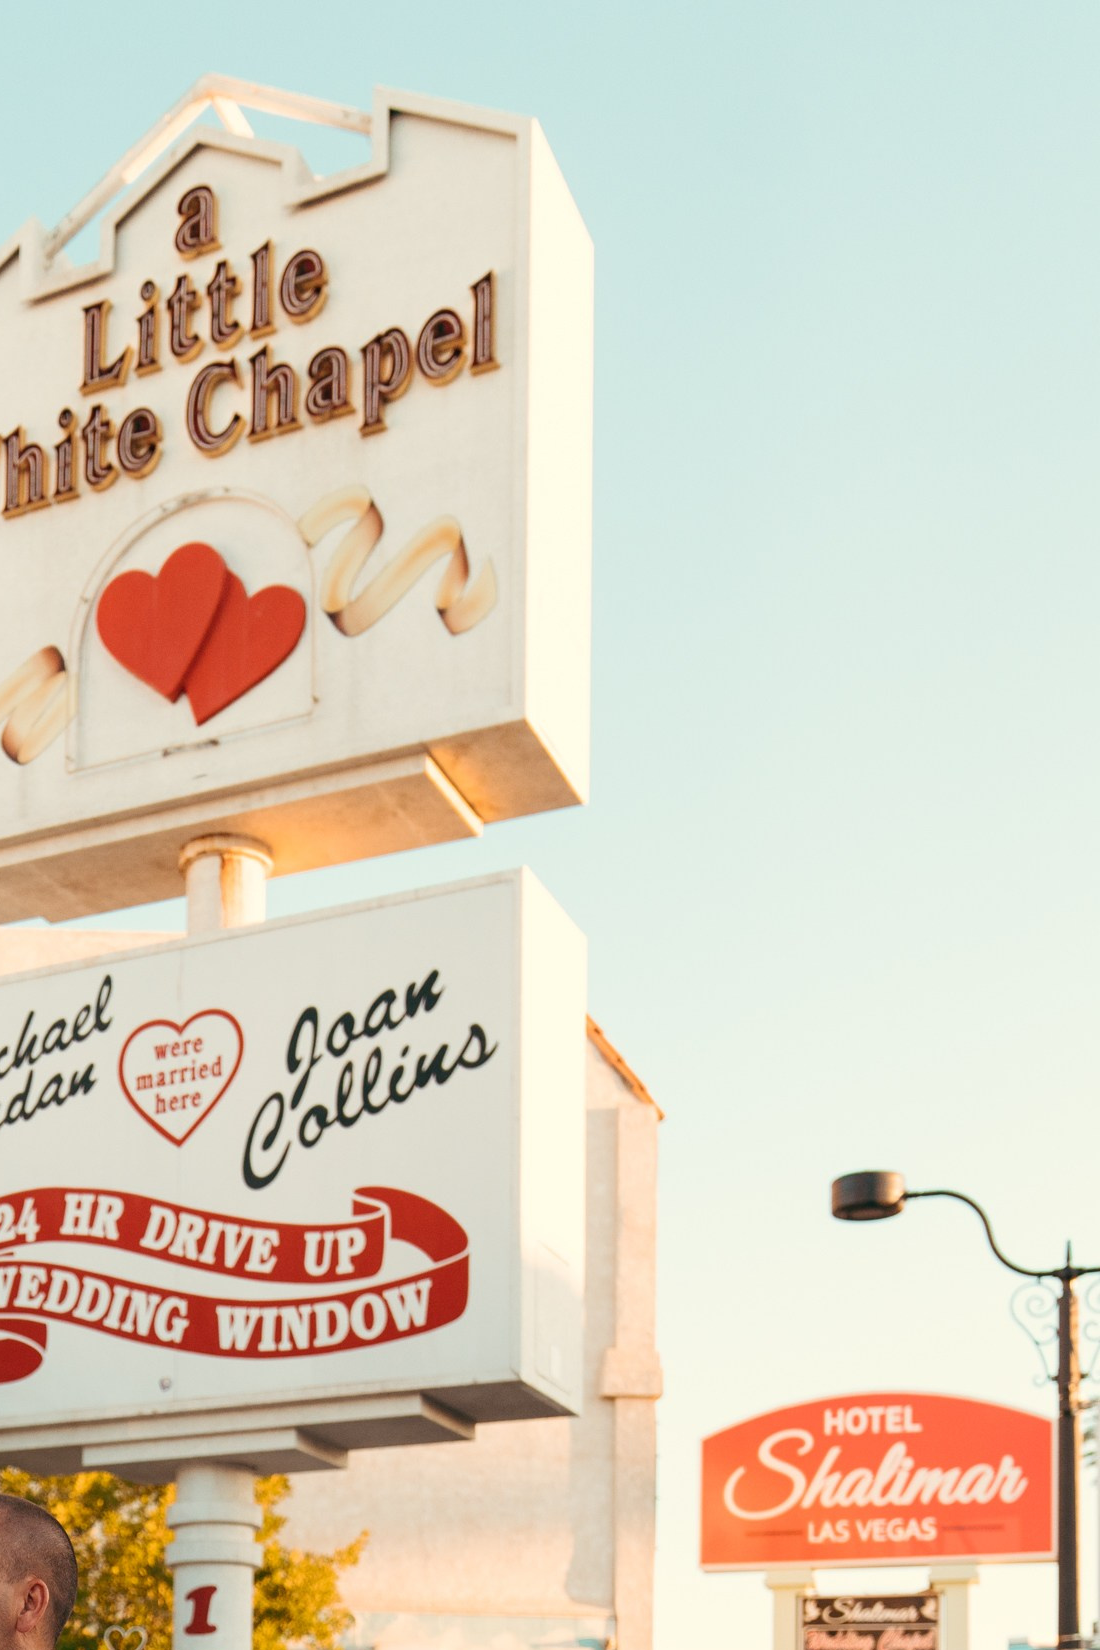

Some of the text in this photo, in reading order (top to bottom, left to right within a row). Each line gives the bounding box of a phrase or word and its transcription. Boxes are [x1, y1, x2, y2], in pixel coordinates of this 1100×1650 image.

[175, 184, 221, 259] a
[80, 239, 328, 396] Little
[186, 270, 500, 458] Chapel
[154, 1036, 203, 1062] were
[286, 968, 445, 1076] Joan
[135, 1056, 223, 1092] married
[154, 1090, 202, 1116] here
[242, 1023, 499, 1191] Collins
[59, 1192, 126, 1242] HR
[140, 1209, 280, 1274] DRIVE
[302, 1228, 367, 1277] UP
[216, 1279, 434, 1353] WINDOW
[823, 1405, 922, 1436] HOTEL
[723, 1428, 1028, 1521] Shalimar
[807, 1516, 938, 1544] LAS VEGAS
